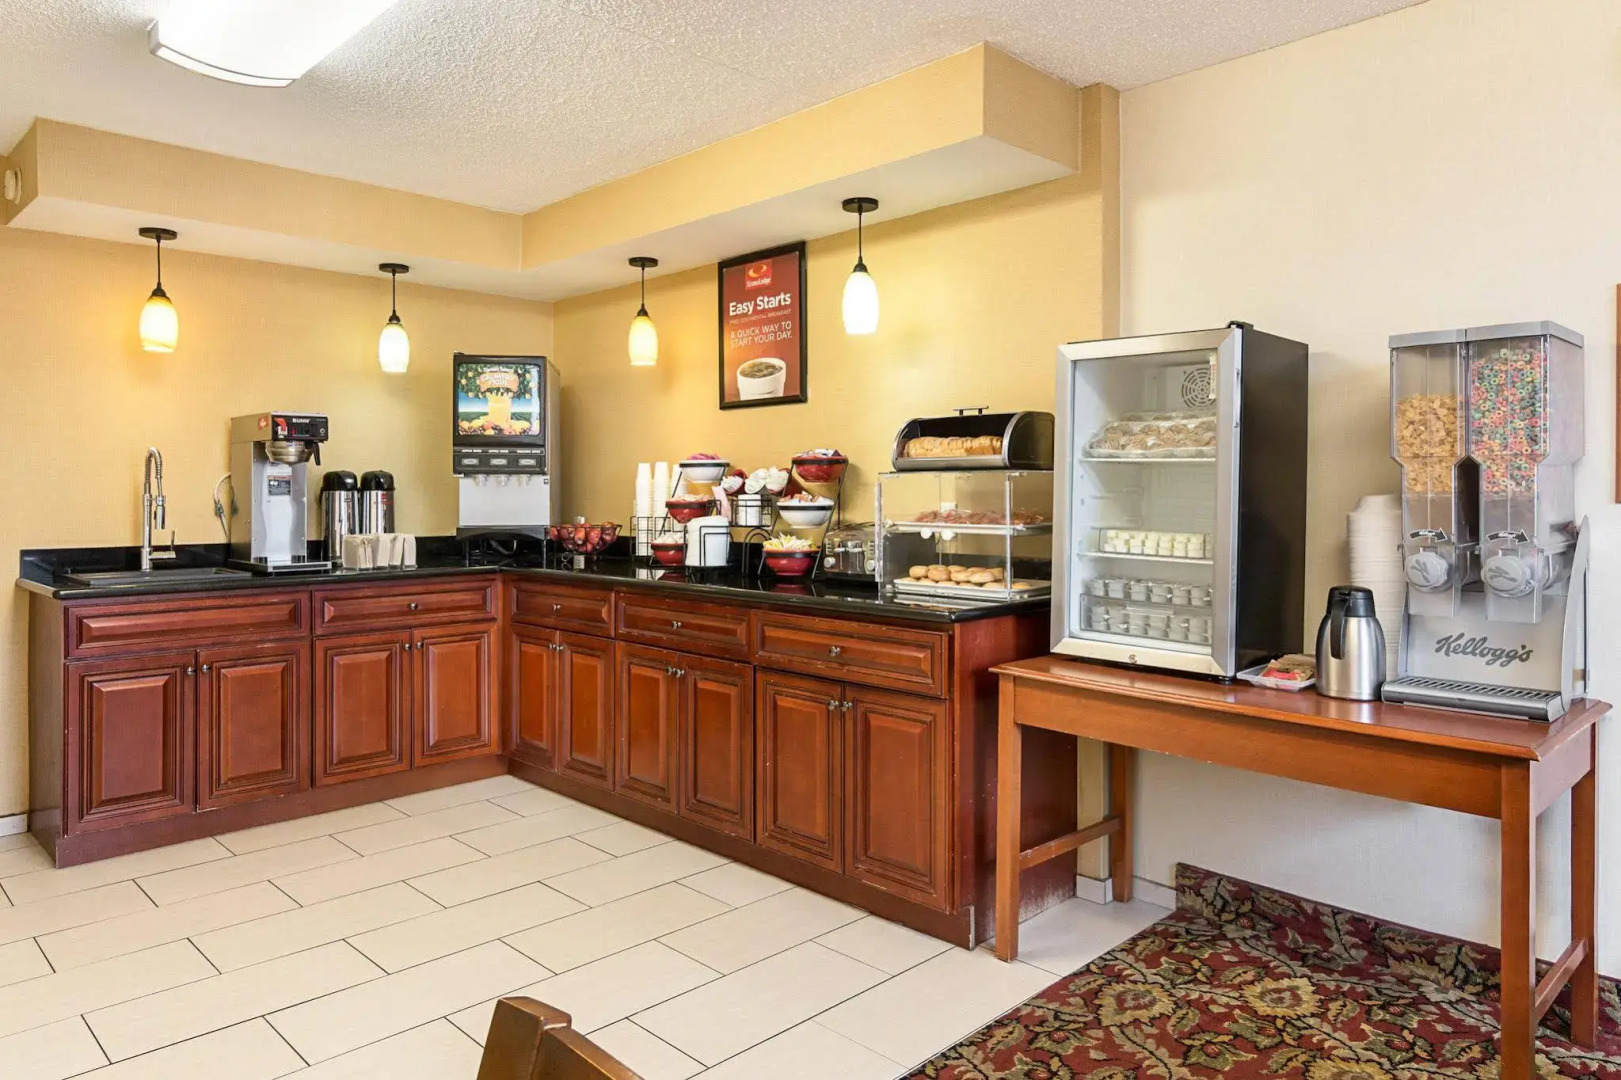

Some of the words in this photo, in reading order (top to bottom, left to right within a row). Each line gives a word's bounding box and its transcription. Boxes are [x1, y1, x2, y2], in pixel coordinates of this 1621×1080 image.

[729, 301, 755, 316] Easy
[756, 292, 792, 310] Starts
[730, 338, 752, 348] START
[753, 333, 775, 344] YOUR
[776, 330, 793, 341] DAY.
[731, 331, 736, 339] A
[736, 326, 760, 338] QUICK
[761, 323, 780, 333] WAY
[781, 321, 792, 330] TO
[1435, 632, 1534, 668] Kellogg's
